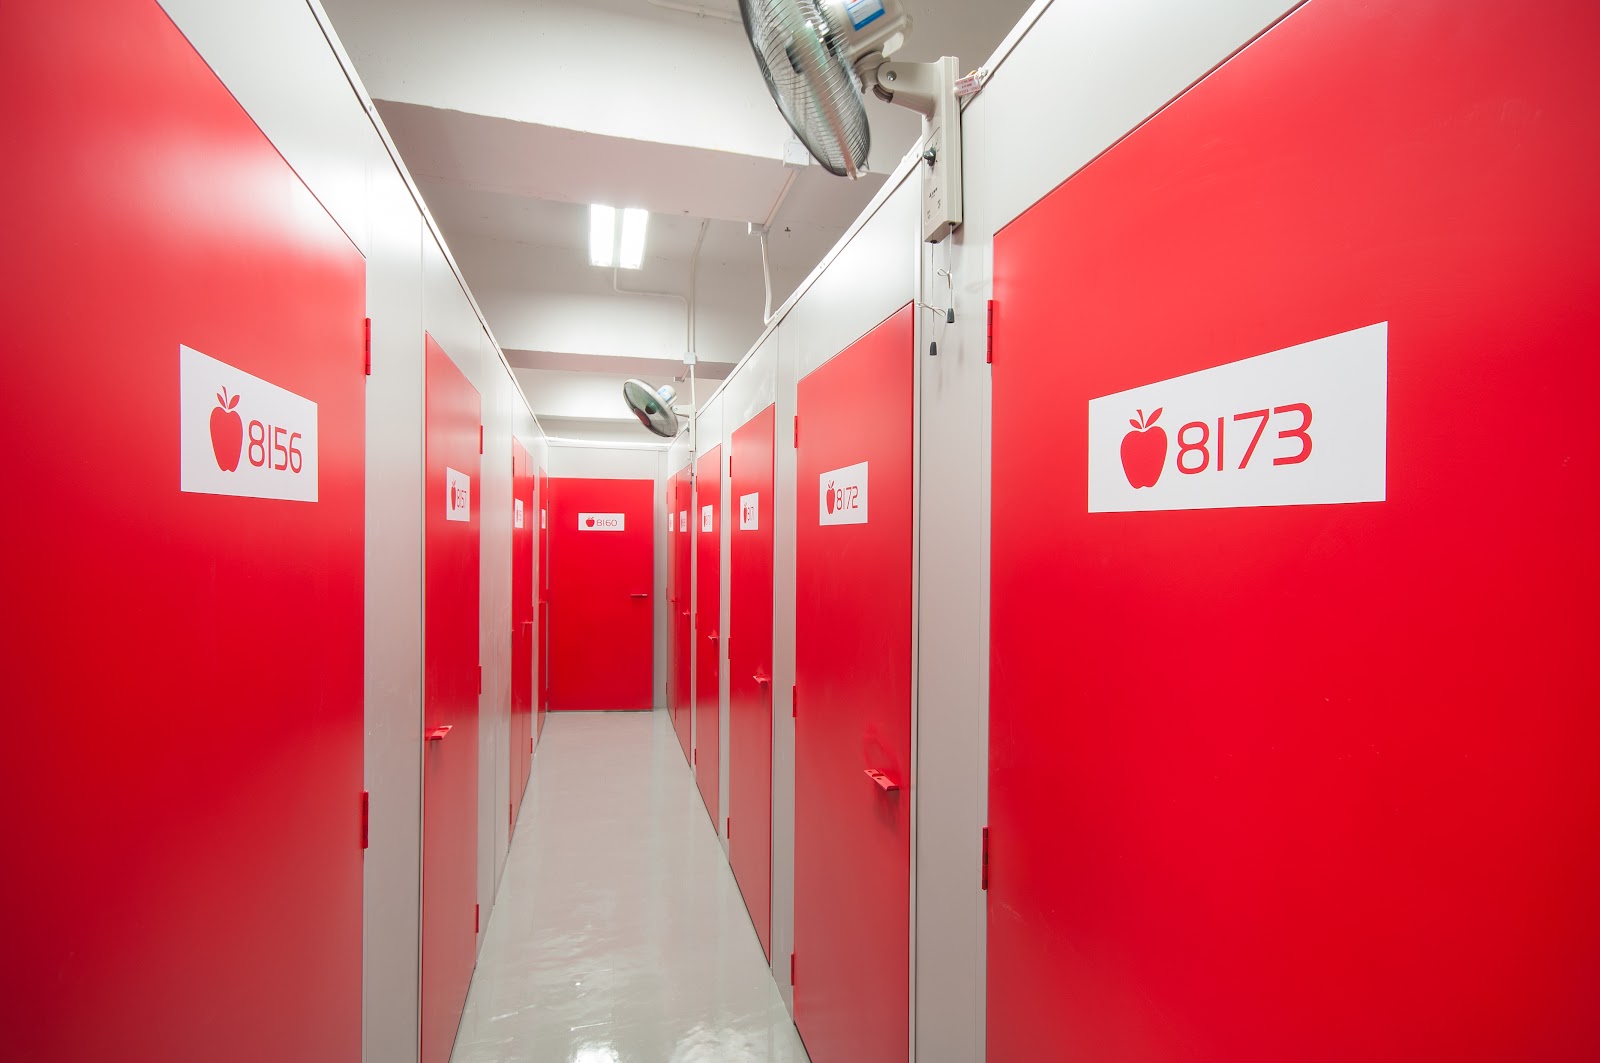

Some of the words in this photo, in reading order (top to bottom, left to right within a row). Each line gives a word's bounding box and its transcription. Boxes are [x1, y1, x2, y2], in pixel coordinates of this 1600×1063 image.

[248, 419, 303, 474] 8156
[1176, 402, 1313, 475] 8173
[836, 485, 859, 511] 8172
[596, 519, 618, 527] 8160
